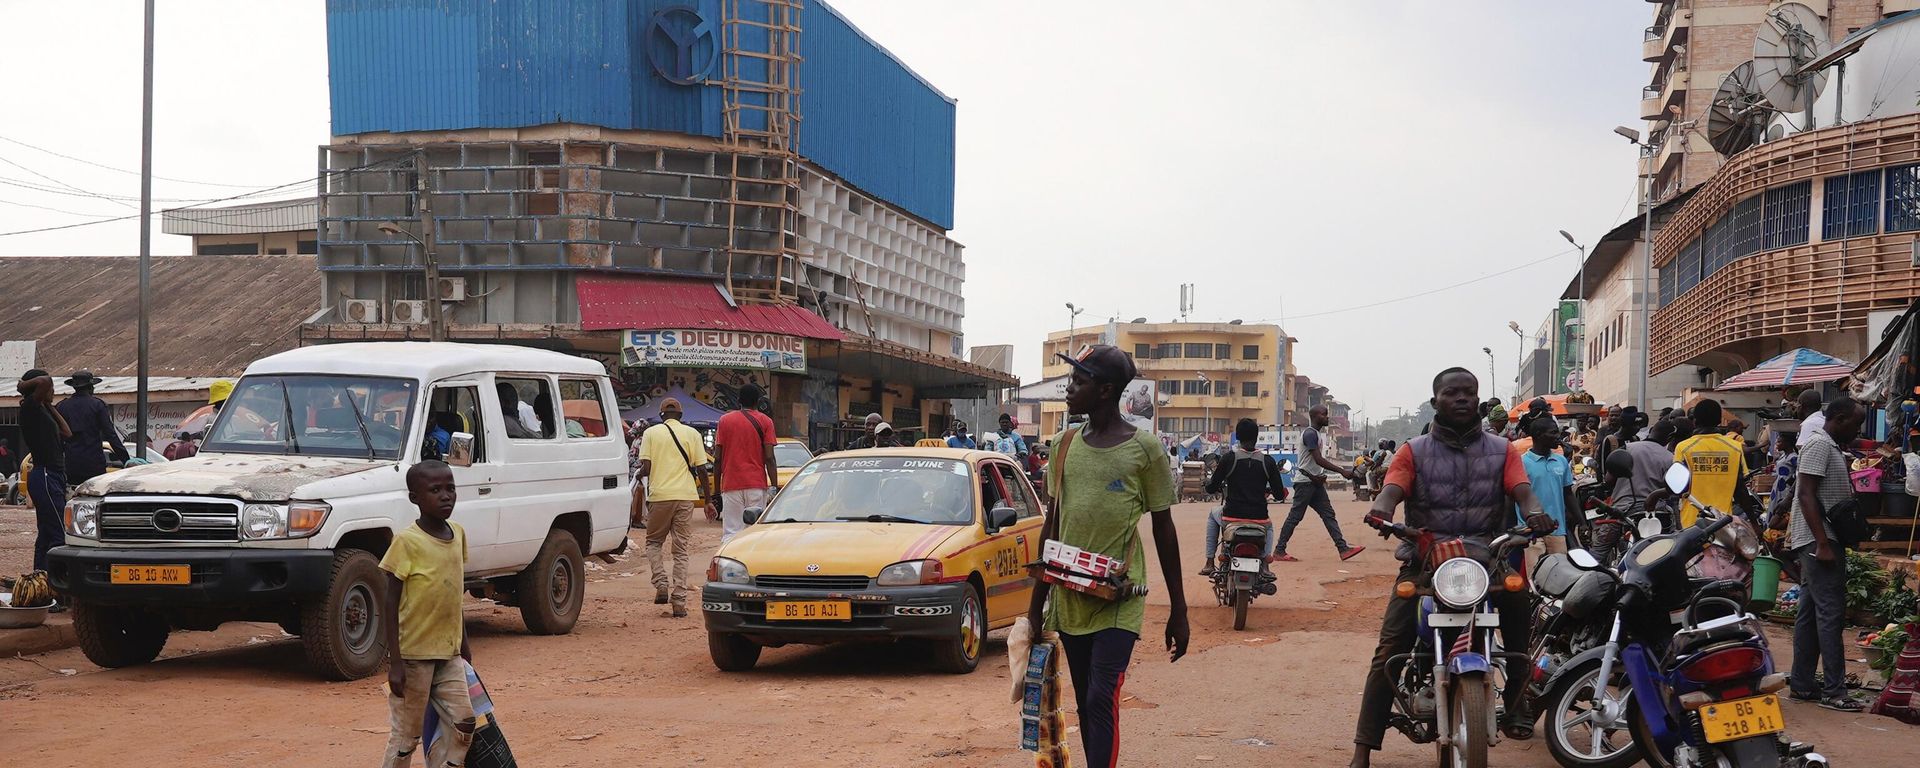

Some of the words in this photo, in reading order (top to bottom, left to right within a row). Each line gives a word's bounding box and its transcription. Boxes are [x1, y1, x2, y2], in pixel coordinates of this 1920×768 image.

[630, 330, 675, 346] ETS
[681, 331, 733, 347] DIEU
[738, 333, 802, 353] DONNE
[919, 440, 941, 448] TAXI
[830, 460, 847, 469] LA
[852, 459, 882, 468] ROSE
[903, 460, 945, 469] DIVINE
[128, 568, 140, 580] BG
[785, 604, 798, 617] BG
[803, 604, 816, 617] 10
[821, 604, 838, 617] AJI
[1735, 701, 1754, 717] BG
[1723, 719, 1750, 737] 318
